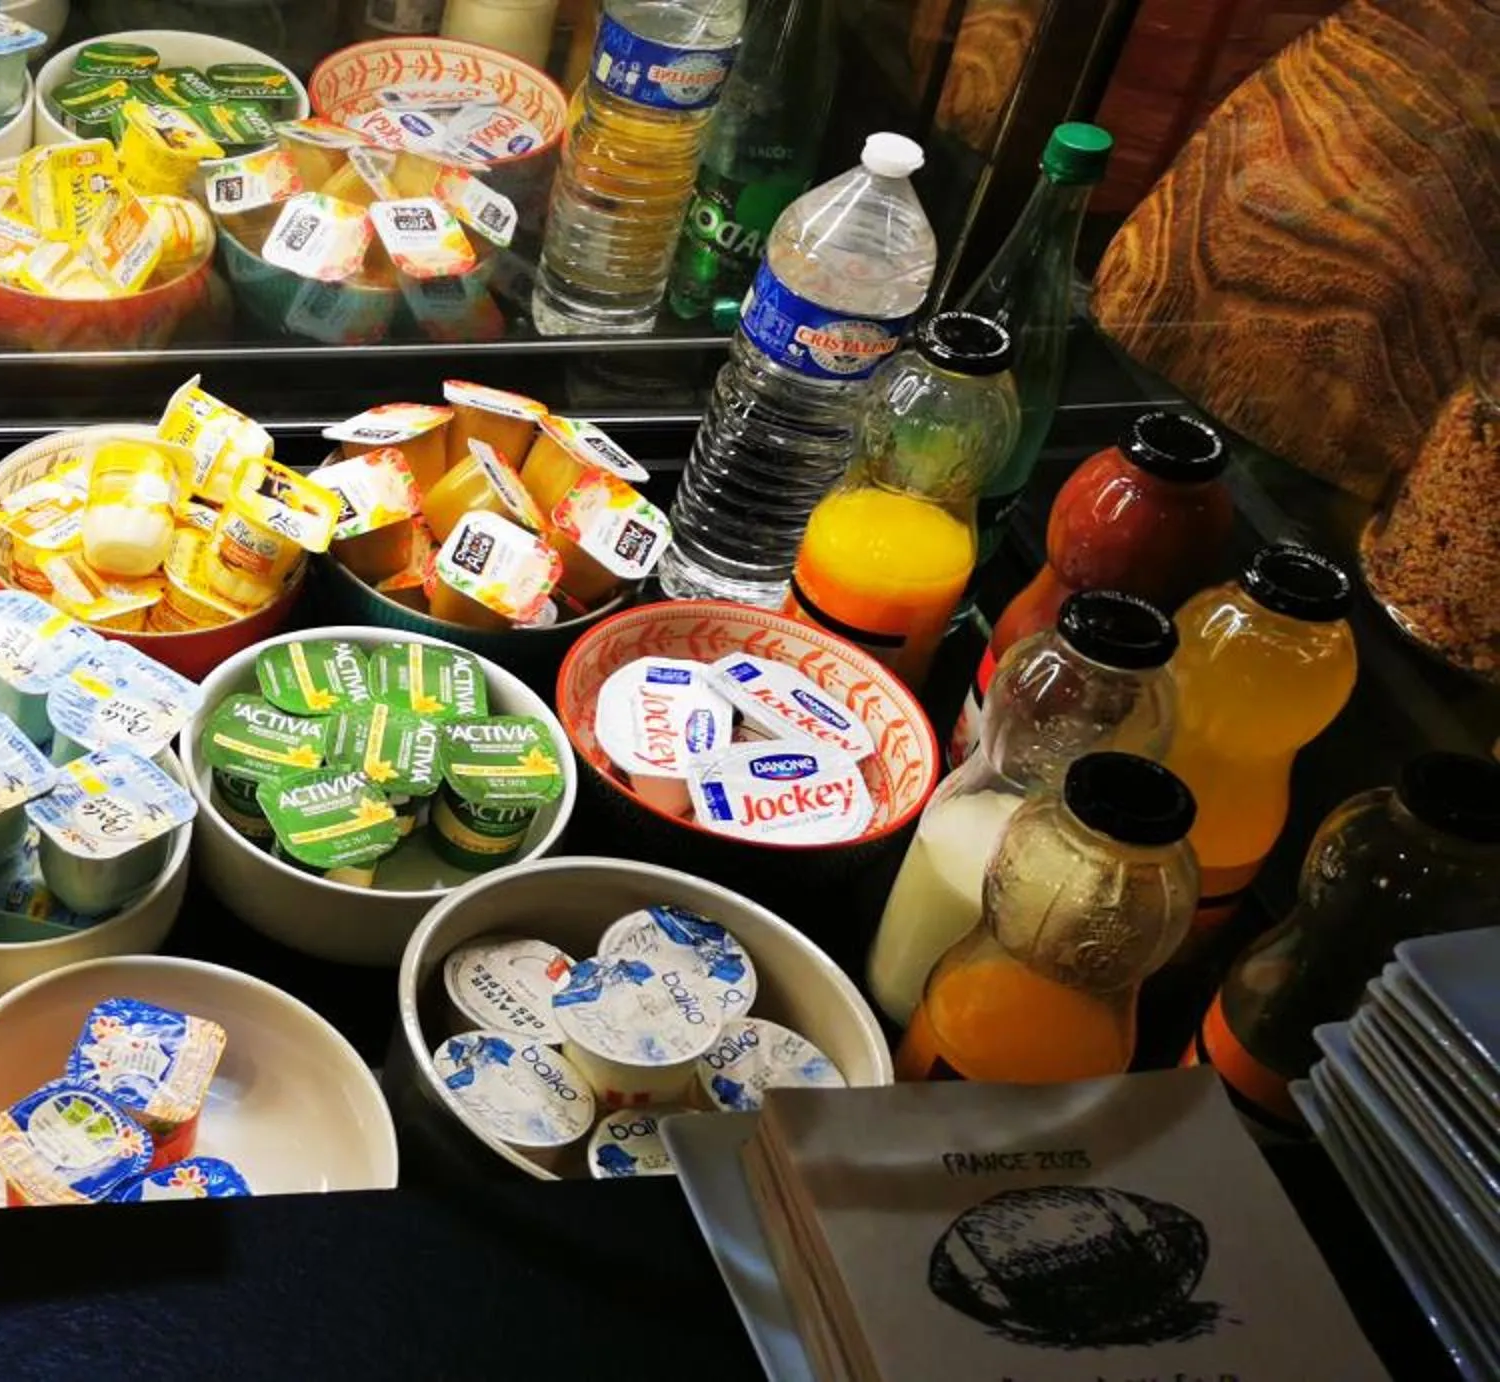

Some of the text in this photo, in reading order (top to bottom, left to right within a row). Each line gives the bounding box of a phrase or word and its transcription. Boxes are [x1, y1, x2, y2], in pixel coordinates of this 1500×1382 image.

[333, 642, 369, 703] ACTIVIA
[451, 653, 477, 716] ACTIVIA
[237, 702, 323, 740] ACTIVIA
[449, 724, 540, 743] ACTIVIA
[633, 685, 679, 772] Jockey
[411, 718, 437, 785] ACTIVIA
[754, 755, 818, 775] DANONE
[278, 771, 369, 810] ACTIVIA
[739, 777, 854, 828] Jockey
[470, 975, 525, 1027] PLAISIR
[473, 963, 545, 1029] DES ALPES
[942, 1151, 1031, 1176] FRANCE
